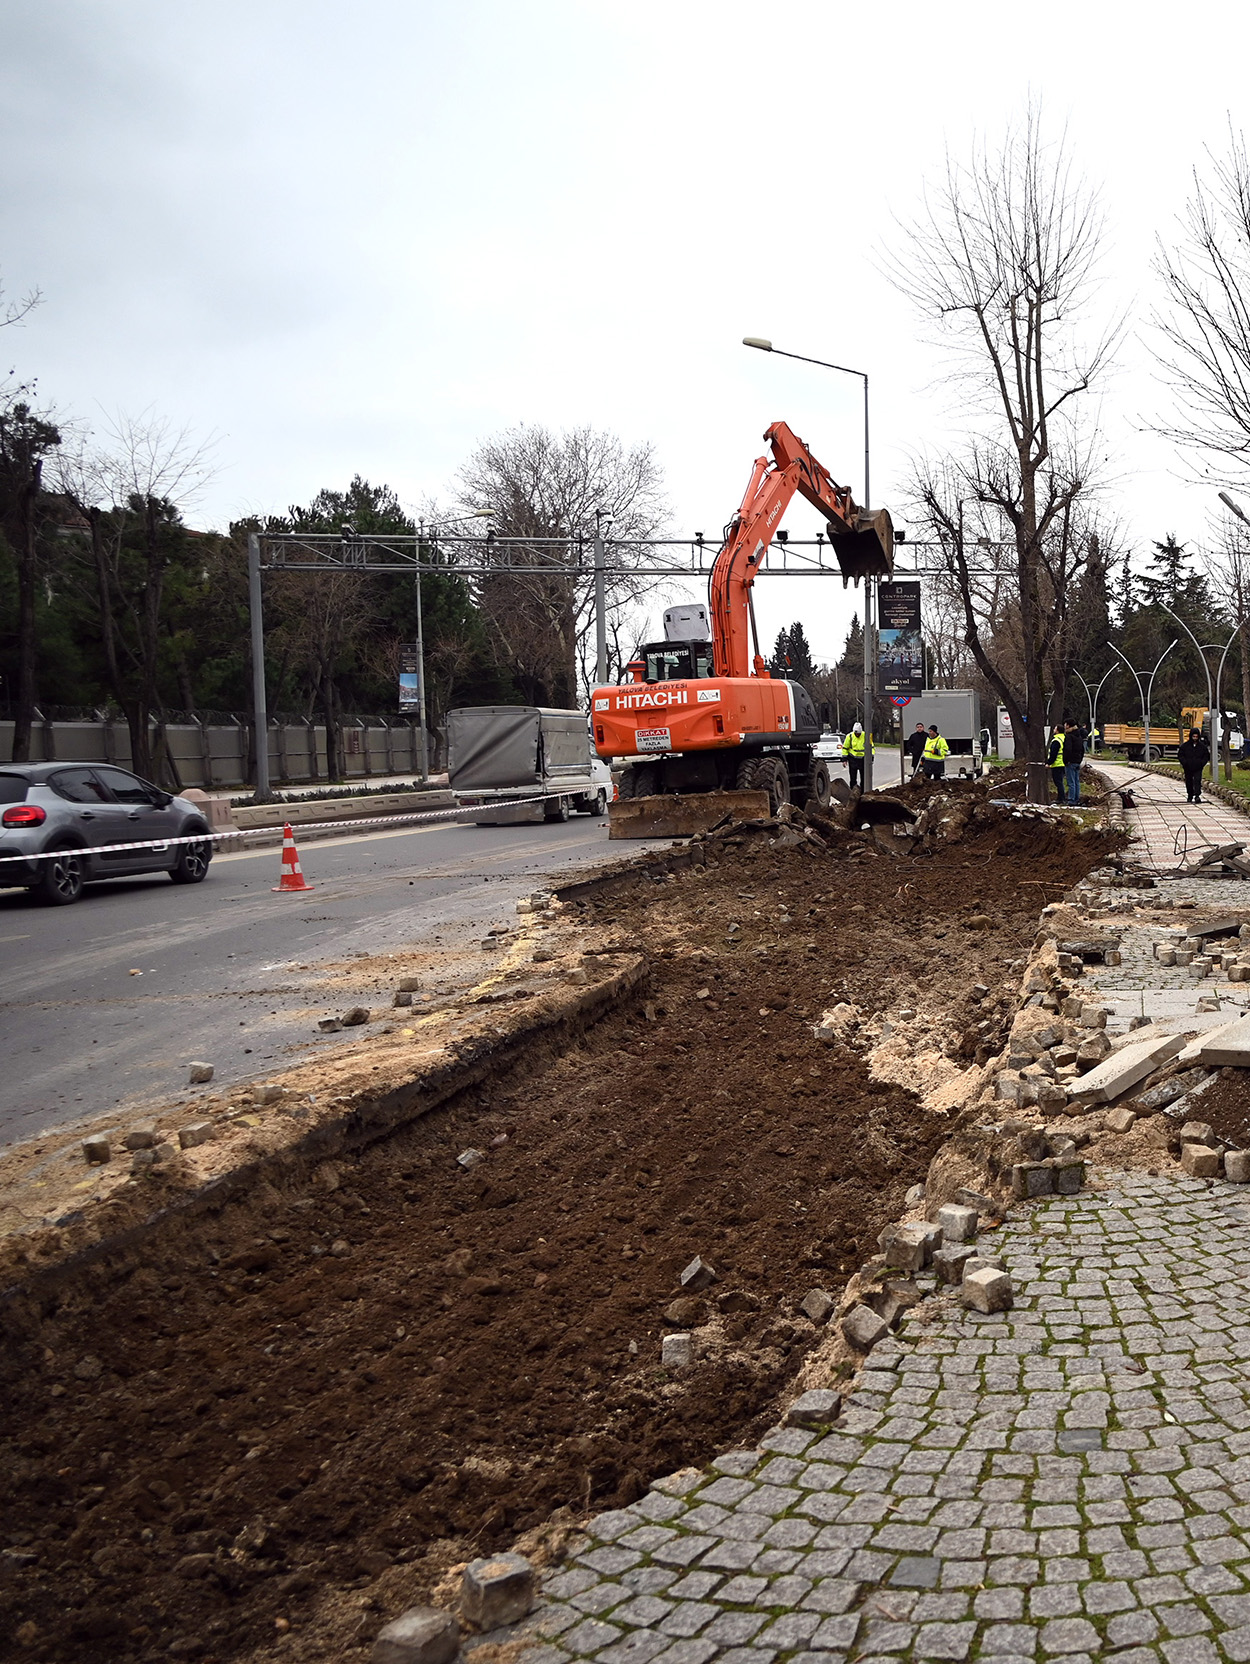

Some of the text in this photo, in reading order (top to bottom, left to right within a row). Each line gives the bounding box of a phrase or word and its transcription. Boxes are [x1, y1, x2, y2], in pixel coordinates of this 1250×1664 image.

[766, 500, 782, 528] HITACHI
[664, 649, 689, 657] BELEDİYESİ
[644, 683, 688, 691] BELEDİYESİ
[616, 691, 688, 710] HITACHI
